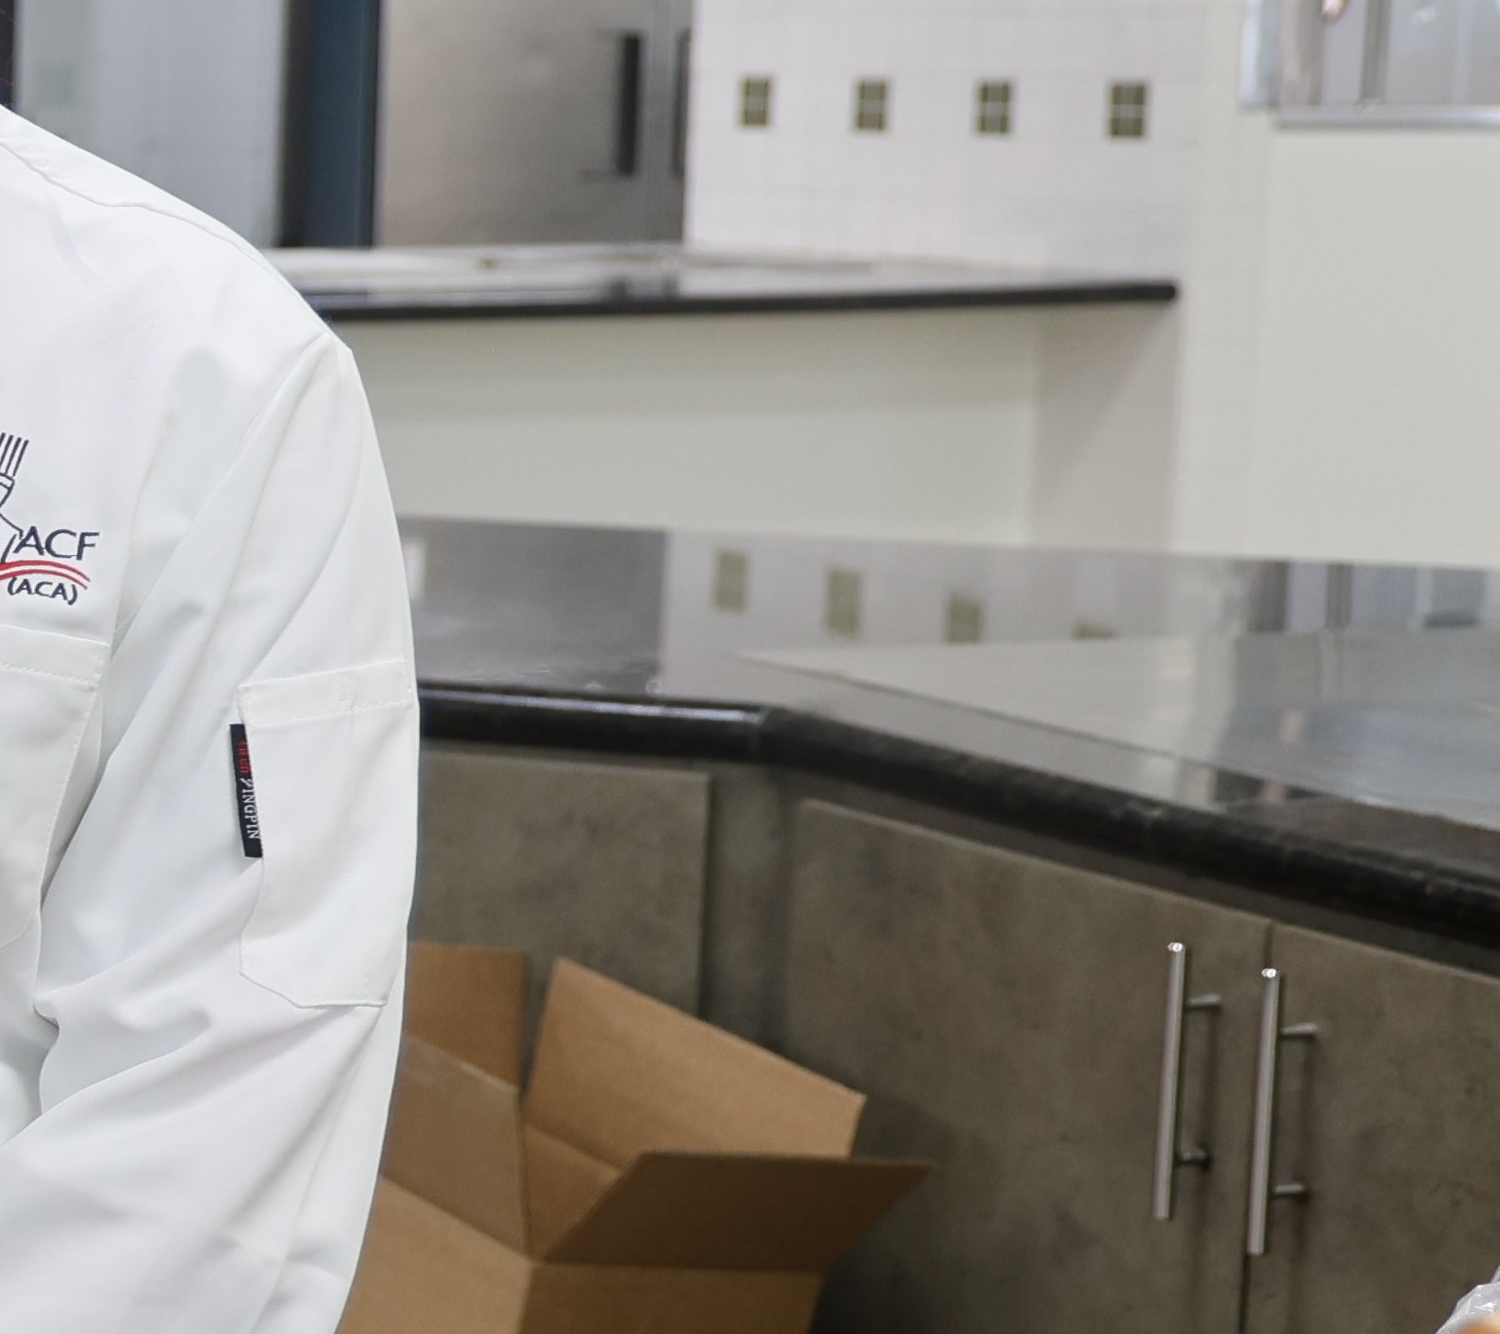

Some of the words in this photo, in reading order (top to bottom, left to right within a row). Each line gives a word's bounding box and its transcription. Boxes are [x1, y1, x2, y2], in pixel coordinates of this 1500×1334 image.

[13, 525, 100, 561] ACF
[7, 575, 78, 606] (ACA)
[239, 777, 261, 839] YINGPIN
